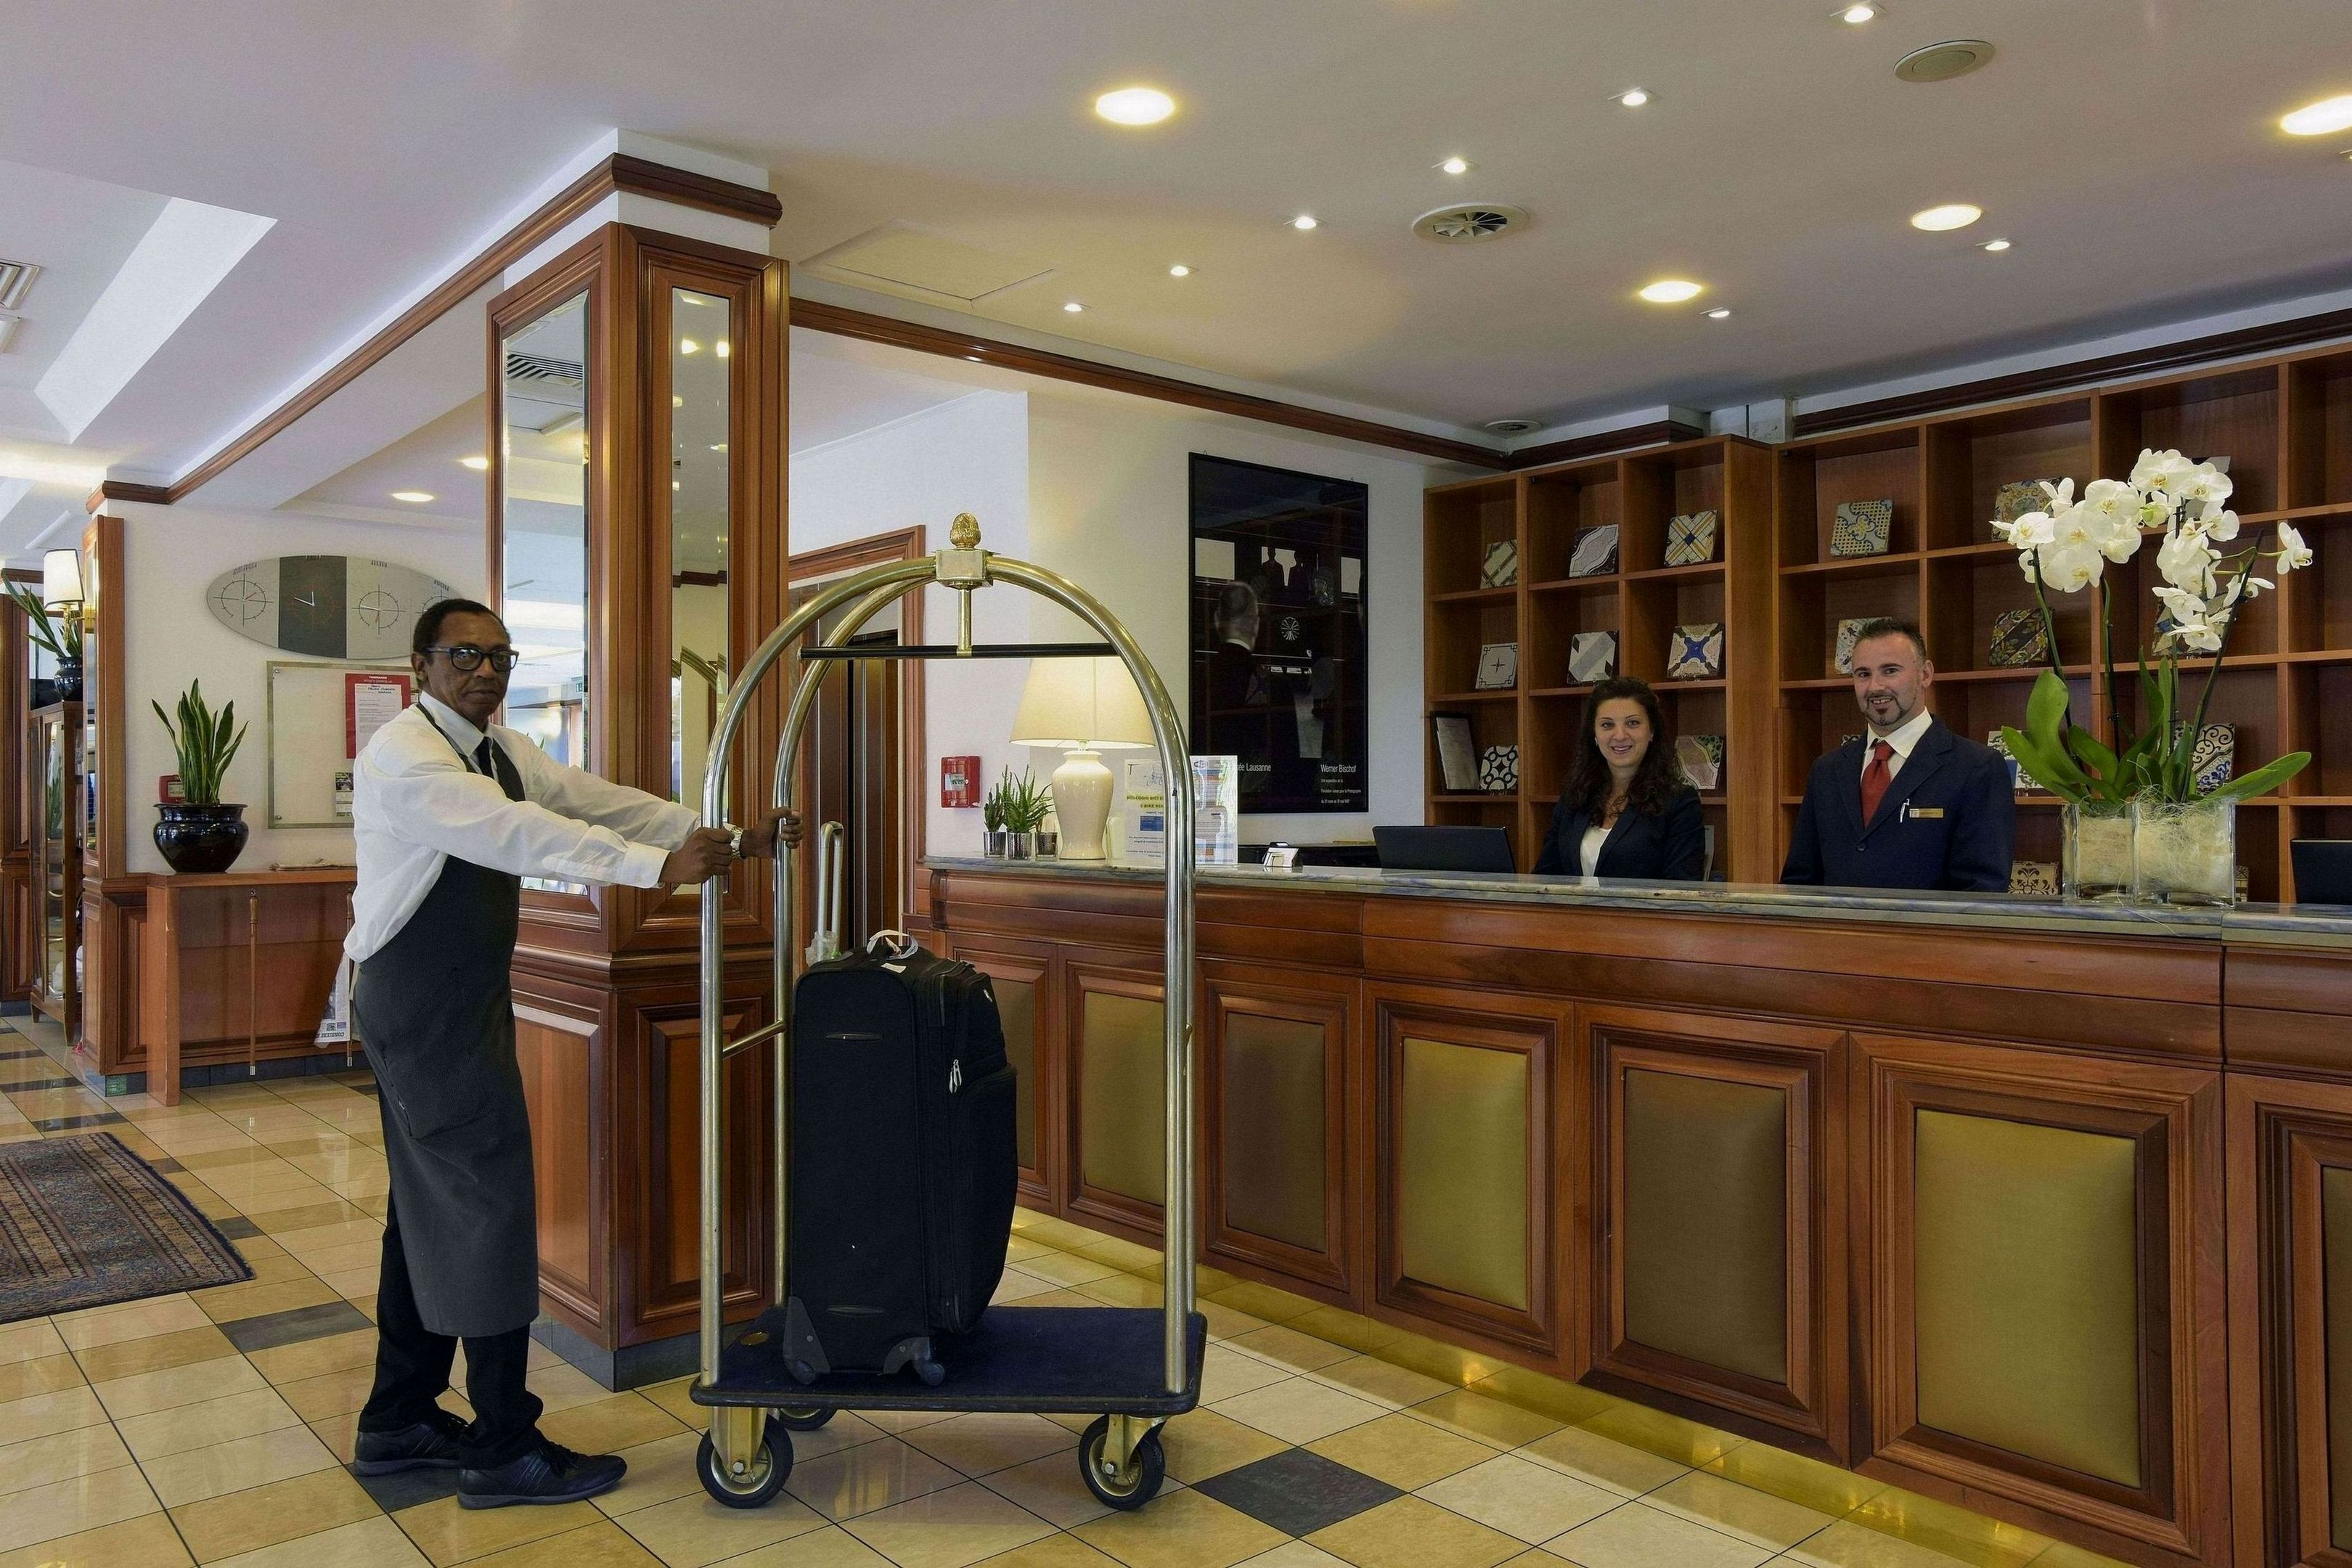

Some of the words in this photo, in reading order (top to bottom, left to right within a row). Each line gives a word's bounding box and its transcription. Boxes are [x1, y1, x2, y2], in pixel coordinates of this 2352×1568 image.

[1246, 763, 1271, 772] Lausanne
[1320, 764, 1338, 772] Werner
[1339, 764, 1357, 773] Bischof
